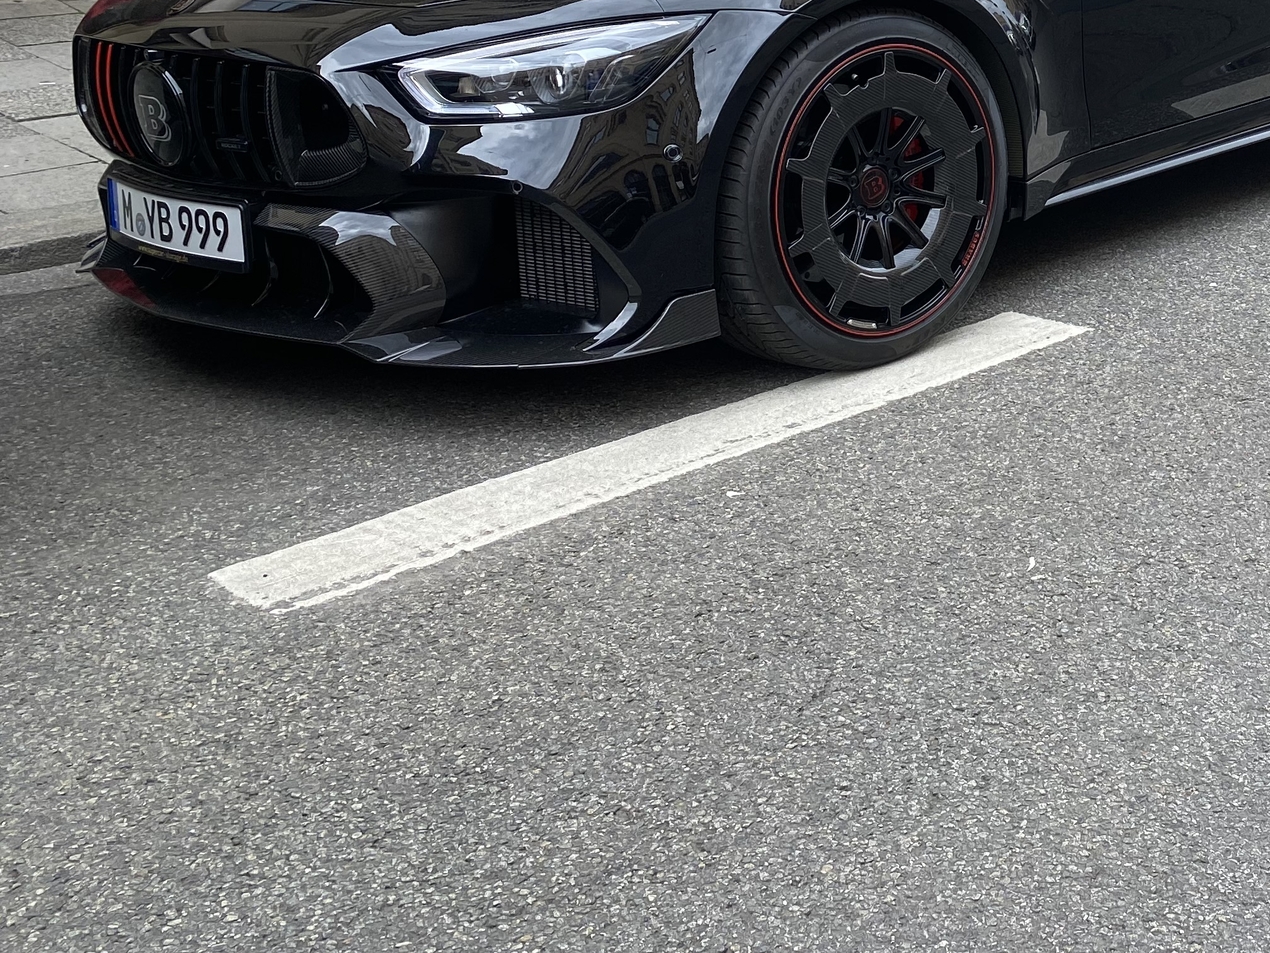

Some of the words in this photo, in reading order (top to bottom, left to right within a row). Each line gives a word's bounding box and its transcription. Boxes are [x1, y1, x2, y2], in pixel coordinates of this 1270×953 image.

[121, 188, 135, 233] M
[143, 197, 174, 243] YB
[178, 205, 229, 253] 999
